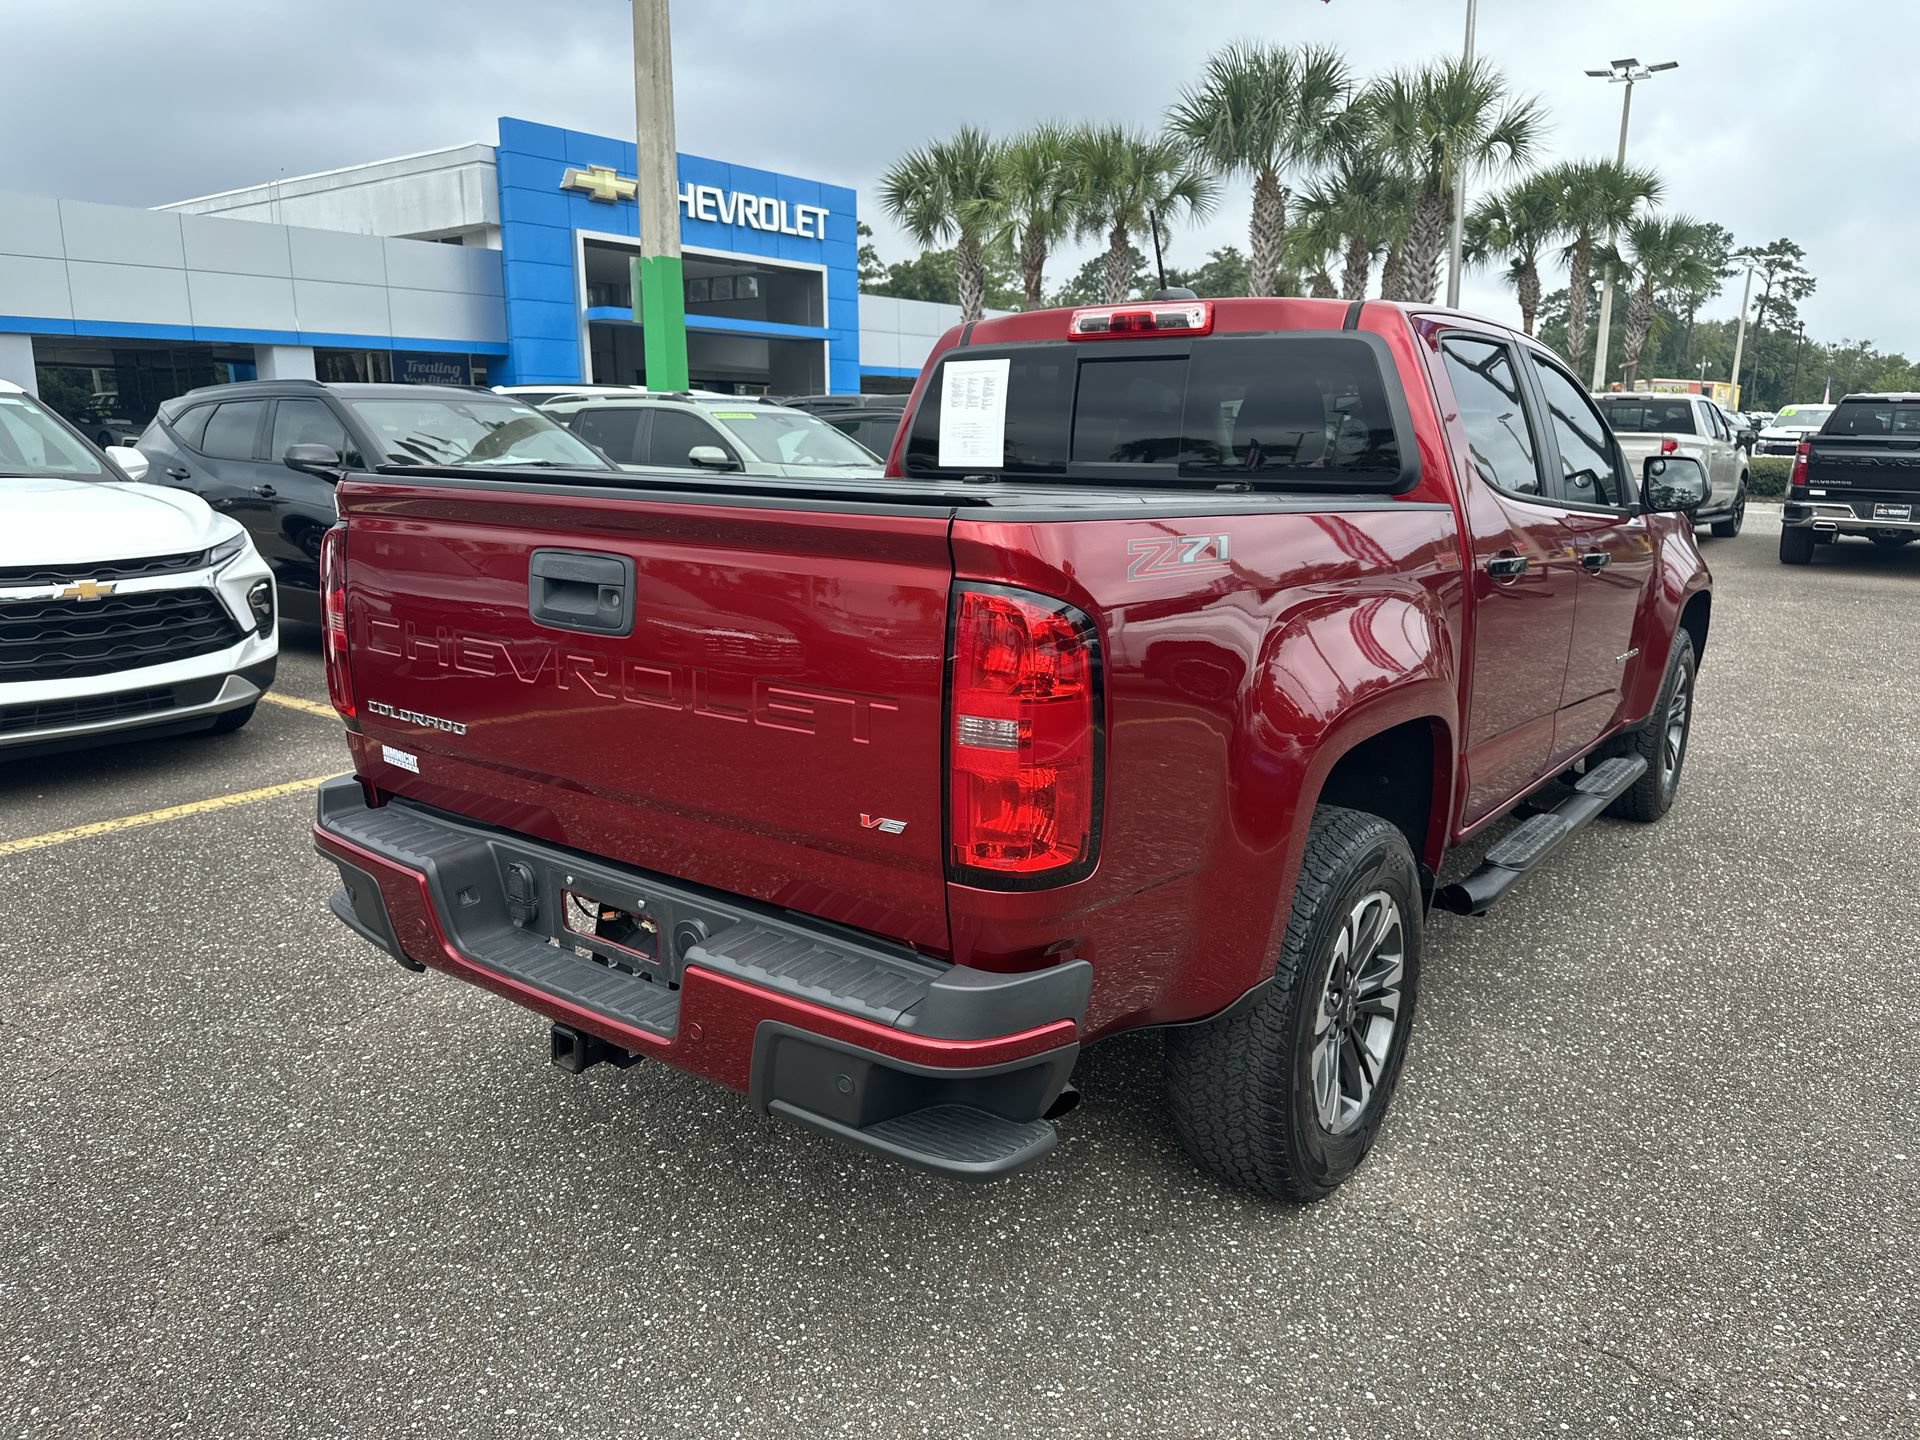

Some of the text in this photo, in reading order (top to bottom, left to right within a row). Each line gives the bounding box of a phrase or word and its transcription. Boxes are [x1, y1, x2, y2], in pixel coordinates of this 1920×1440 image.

[677, 181, 830, 240] HEVROLET
[405, 360, 461, 378] Treating
[1127, 533, 1231, 582] Z71
[366, 613, 900, 744] CHEVROLET
[367, 700, 467, 735] COLORADO
[860, 813, 909, 834] V6
